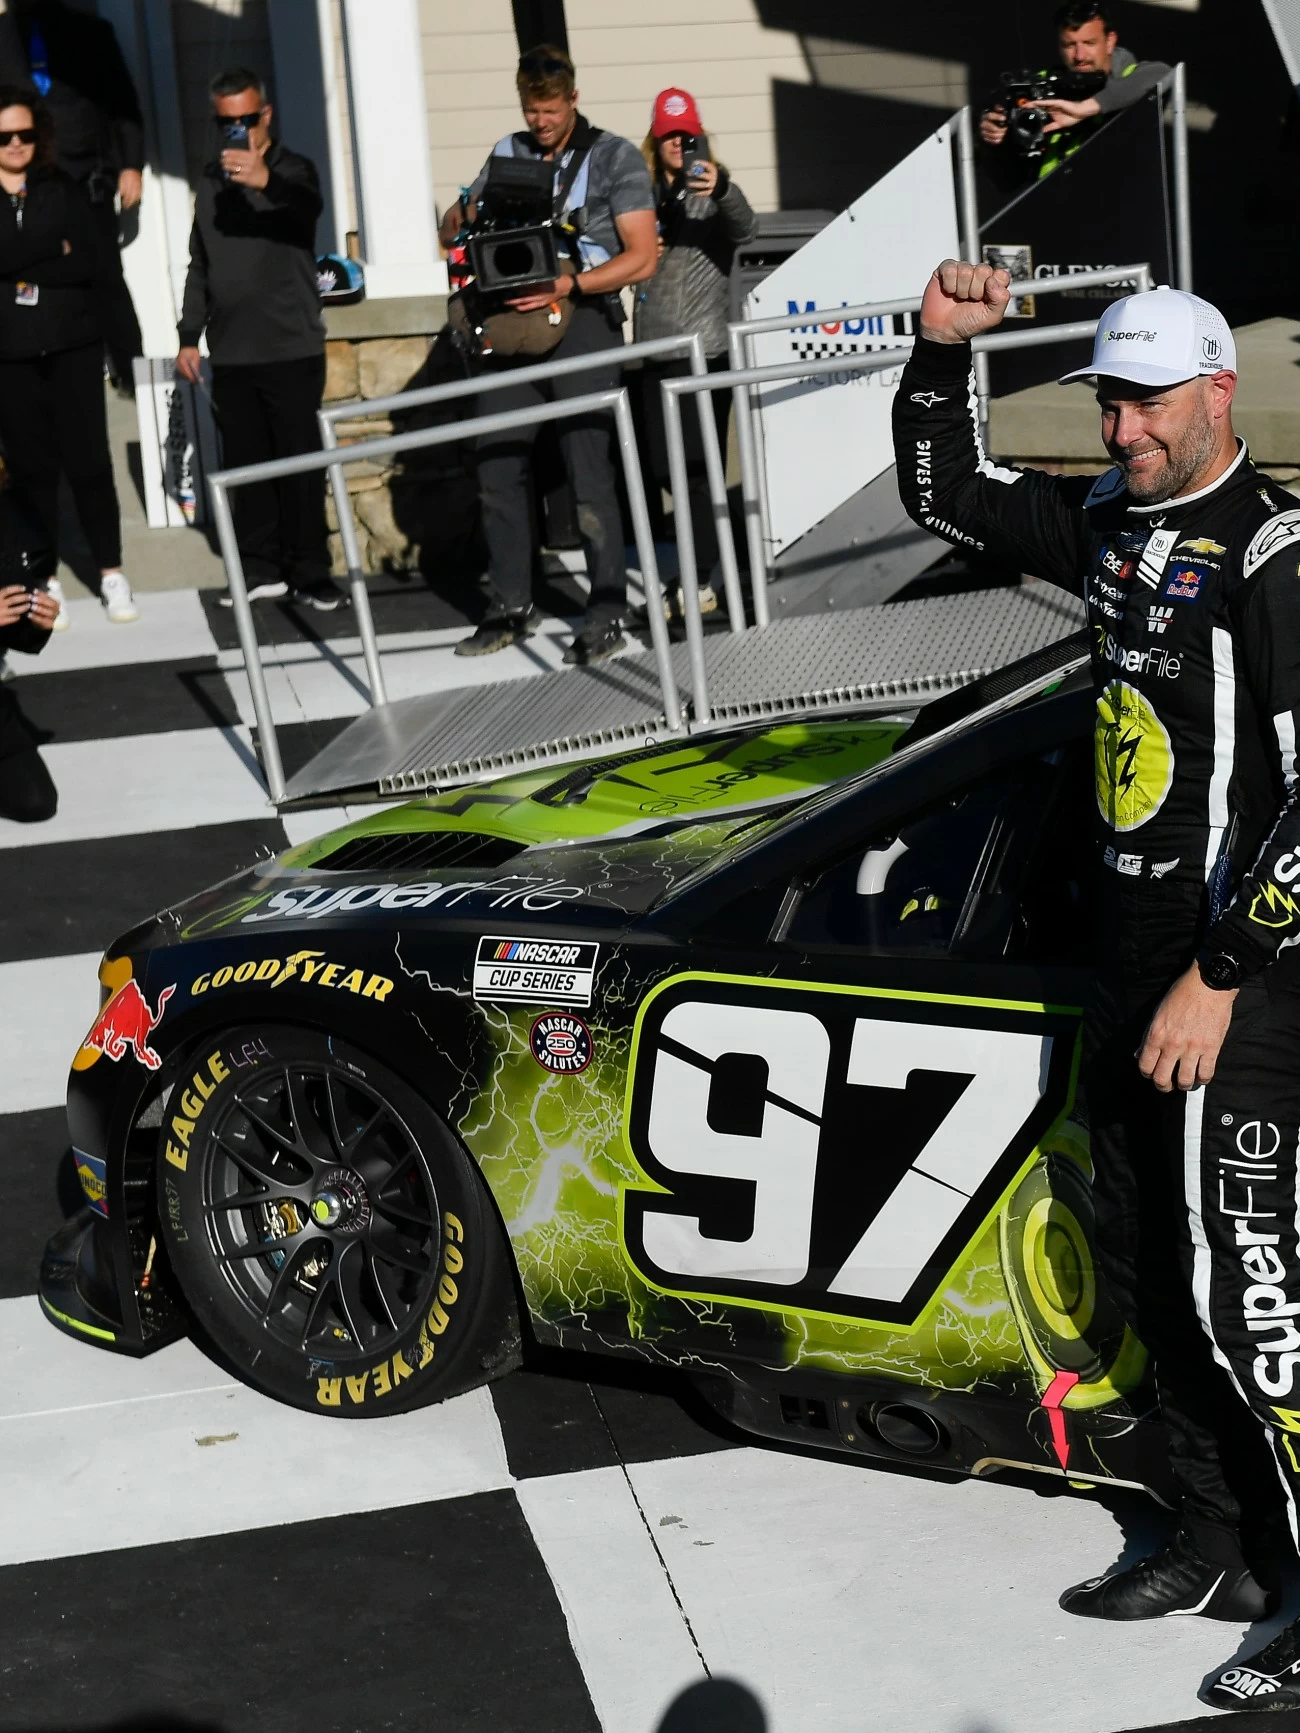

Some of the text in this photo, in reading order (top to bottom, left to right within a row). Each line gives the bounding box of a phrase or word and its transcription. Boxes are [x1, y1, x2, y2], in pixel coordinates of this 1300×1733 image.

[916, 440, 931, 485] GIVES
[241, 876, 585, 925] SuperFile
[514, 943, 581, 965] NASCAR
[489, 969, 577, 991] CUP SERIES
[538, 1017, 584, 1038] NASCAR
[547, 1038, 576, 1050] 250
[538, 1049, 587, 1071] SALUTES
[164, 1050, 231, 1173] EAGLE
[642, 1001, 1055, 1303] 97
